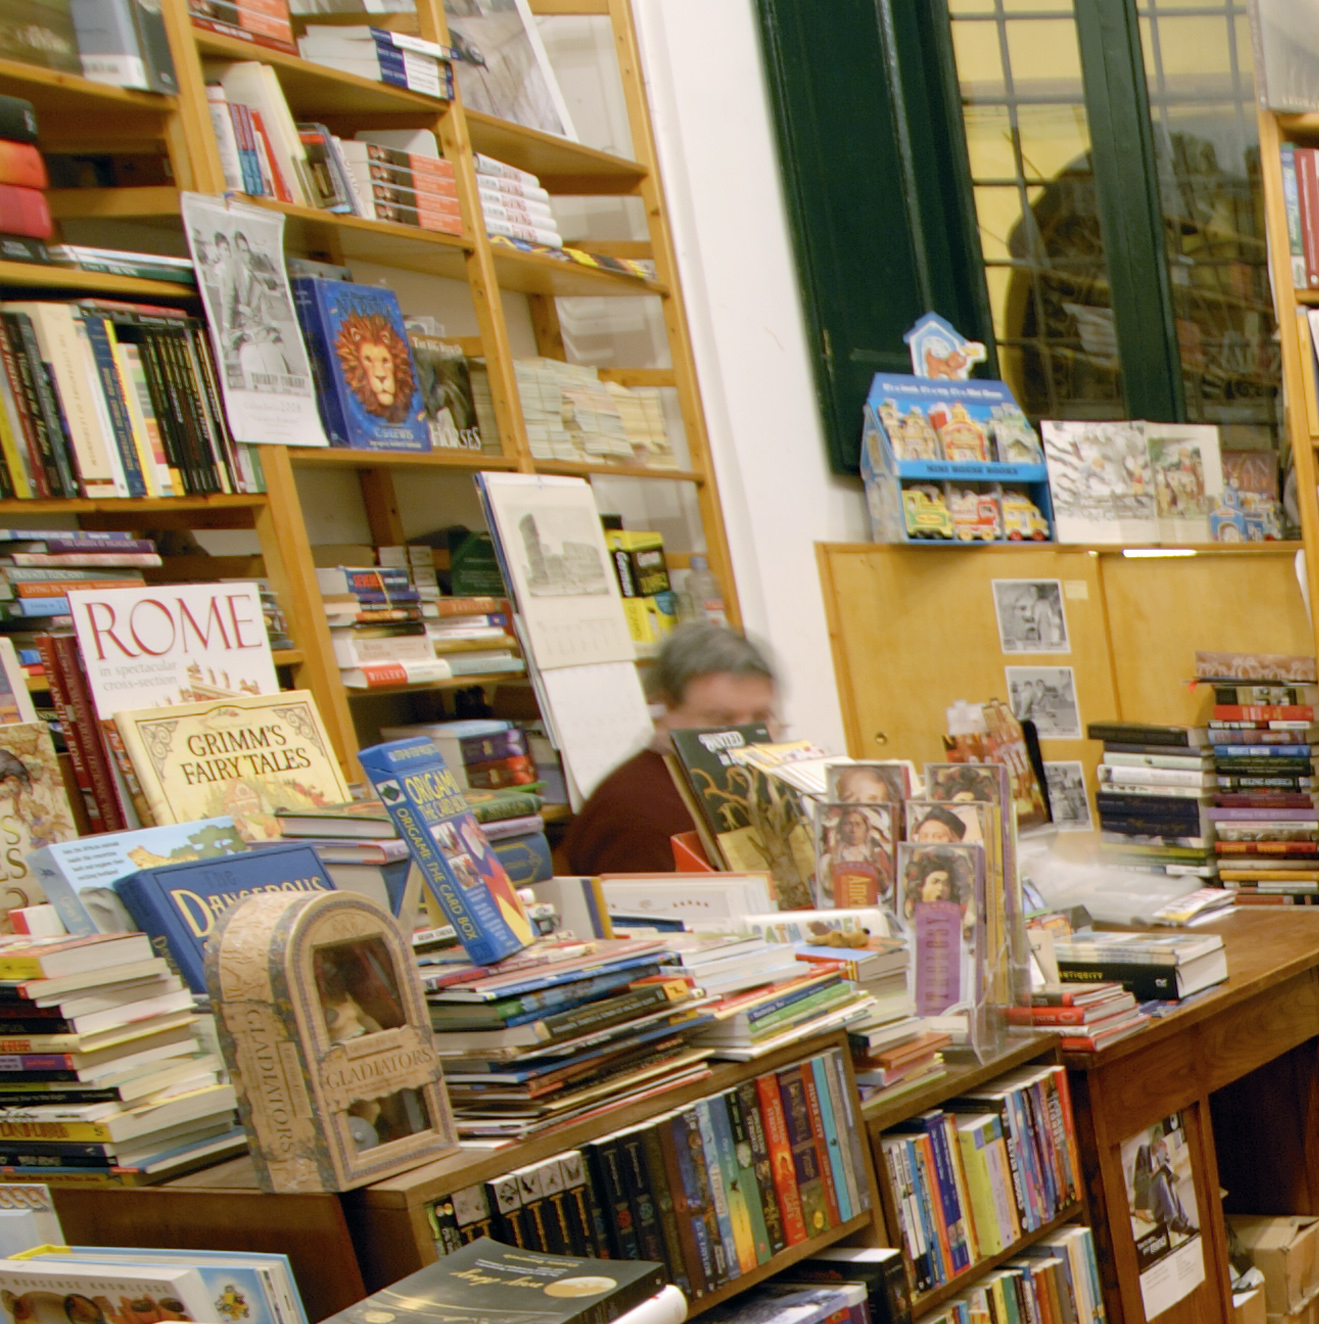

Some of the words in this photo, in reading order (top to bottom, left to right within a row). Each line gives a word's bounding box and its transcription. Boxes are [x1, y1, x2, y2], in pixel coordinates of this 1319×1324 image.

[429, 414, 483, 450] HORSES
[83, 594, 262, 660] ROME
[100, 667, 111, 677] in
[114, 660, 178, 680] spectacular
[187, 724, 287, 758] GRIMM'S
[180, 754, 246, 786] FAIRY
[244, 748, 311, 776] TALES
[245, 1009, 295, 1150] GLADIATORS
[326, 1045, 433, 1091] GLADIATORS
